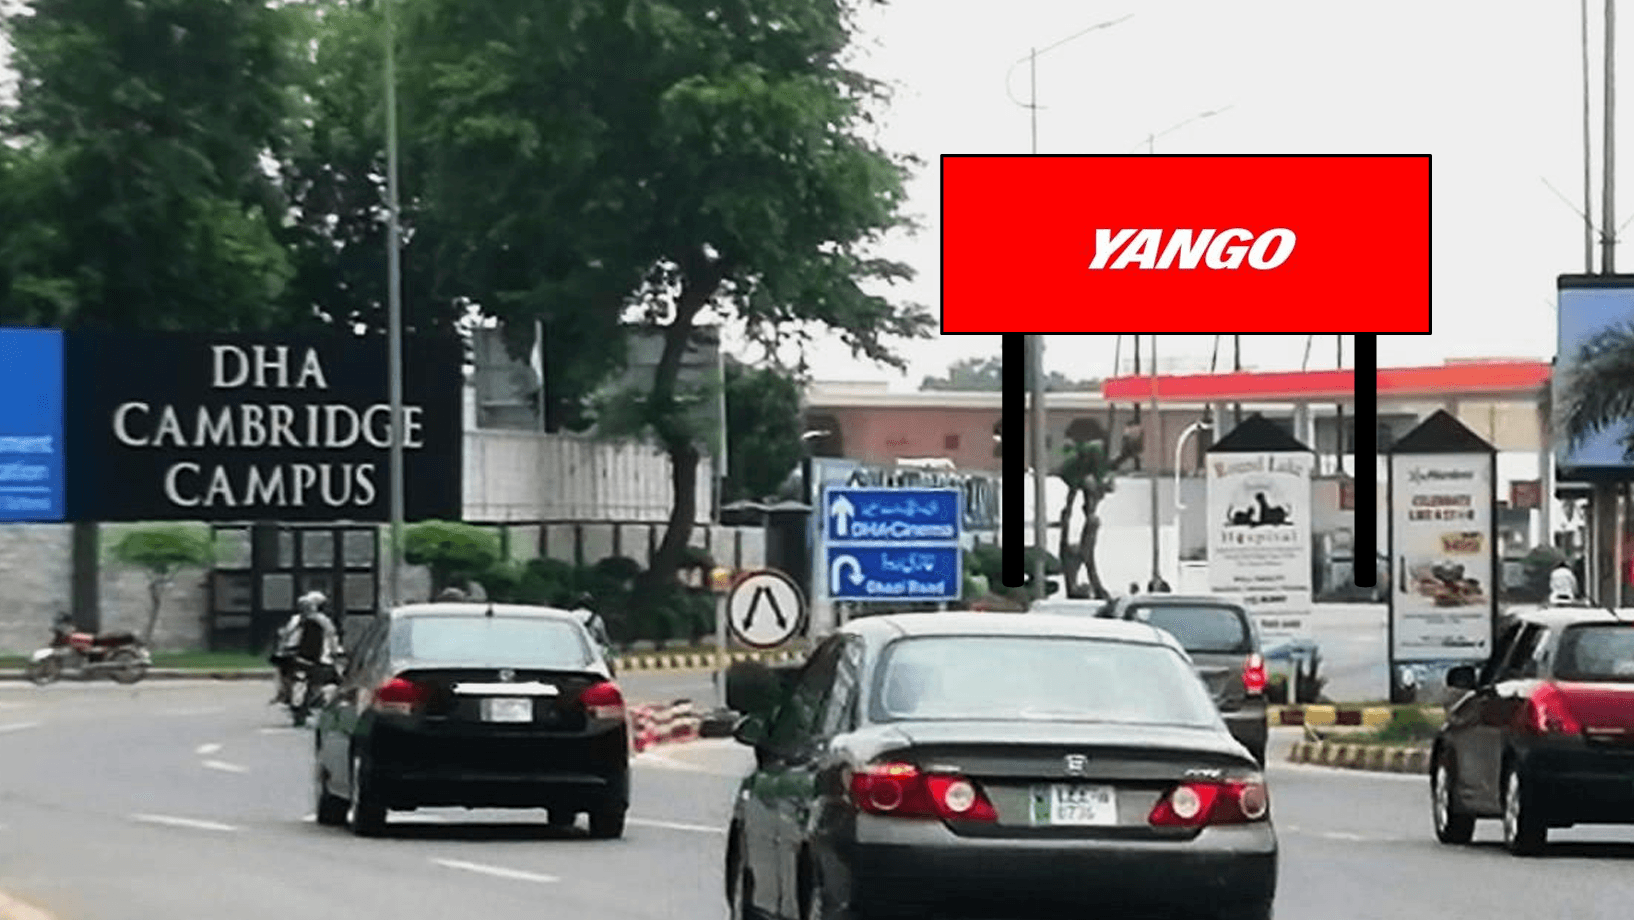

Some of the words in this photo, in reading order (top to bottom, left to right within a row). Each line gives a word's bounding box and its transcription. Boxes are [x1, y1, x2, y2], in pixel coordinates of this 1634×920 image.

[1088, 228, 1296, 270] YANGO
[212, 345, 328, 389] DHA
[113, 402, 424, 448] CAMBRIDGE
[165, 462, 376, 507] CAMPUS
